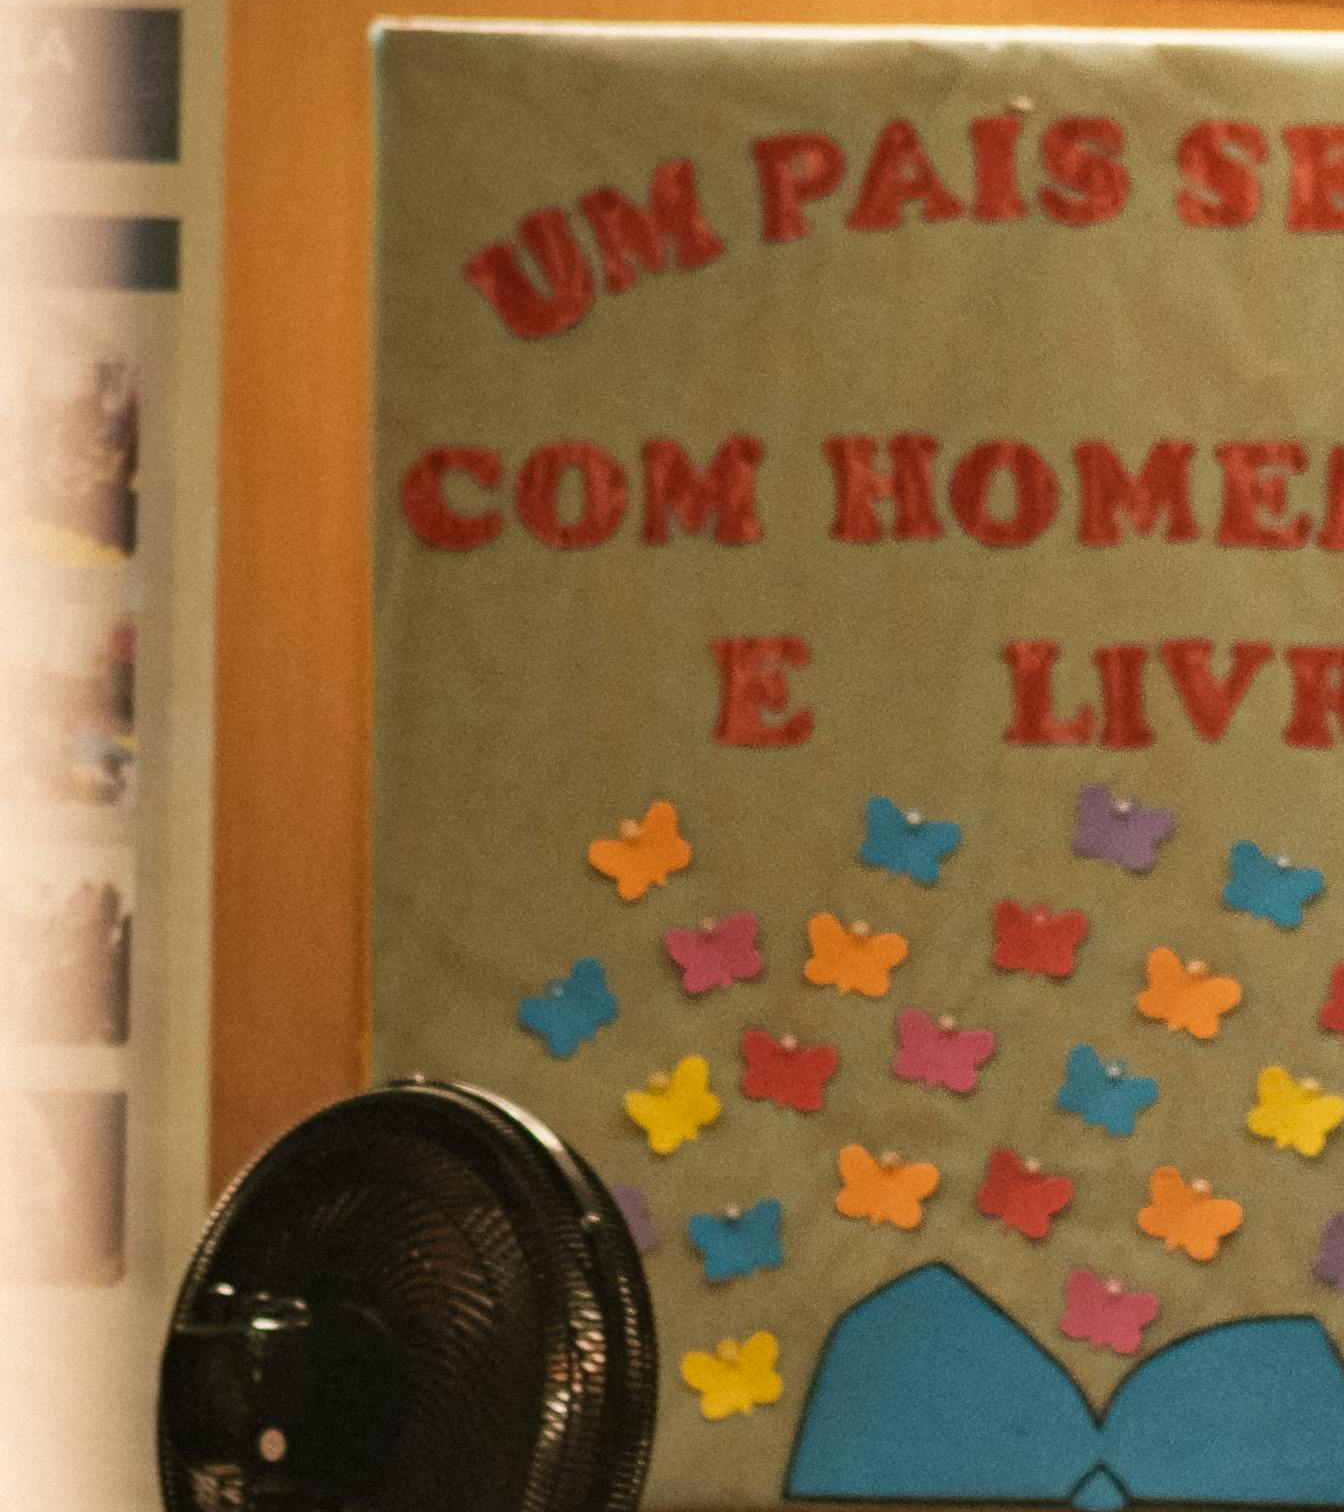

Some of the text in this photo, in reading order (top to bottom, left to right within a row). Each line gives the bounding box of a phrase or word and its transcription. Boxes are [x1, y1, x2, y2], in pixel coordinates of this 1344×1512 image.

[465, 160, 722, 337] UM
[402, 435, 763, 549] COM
[710, 636, 813, 747] E
